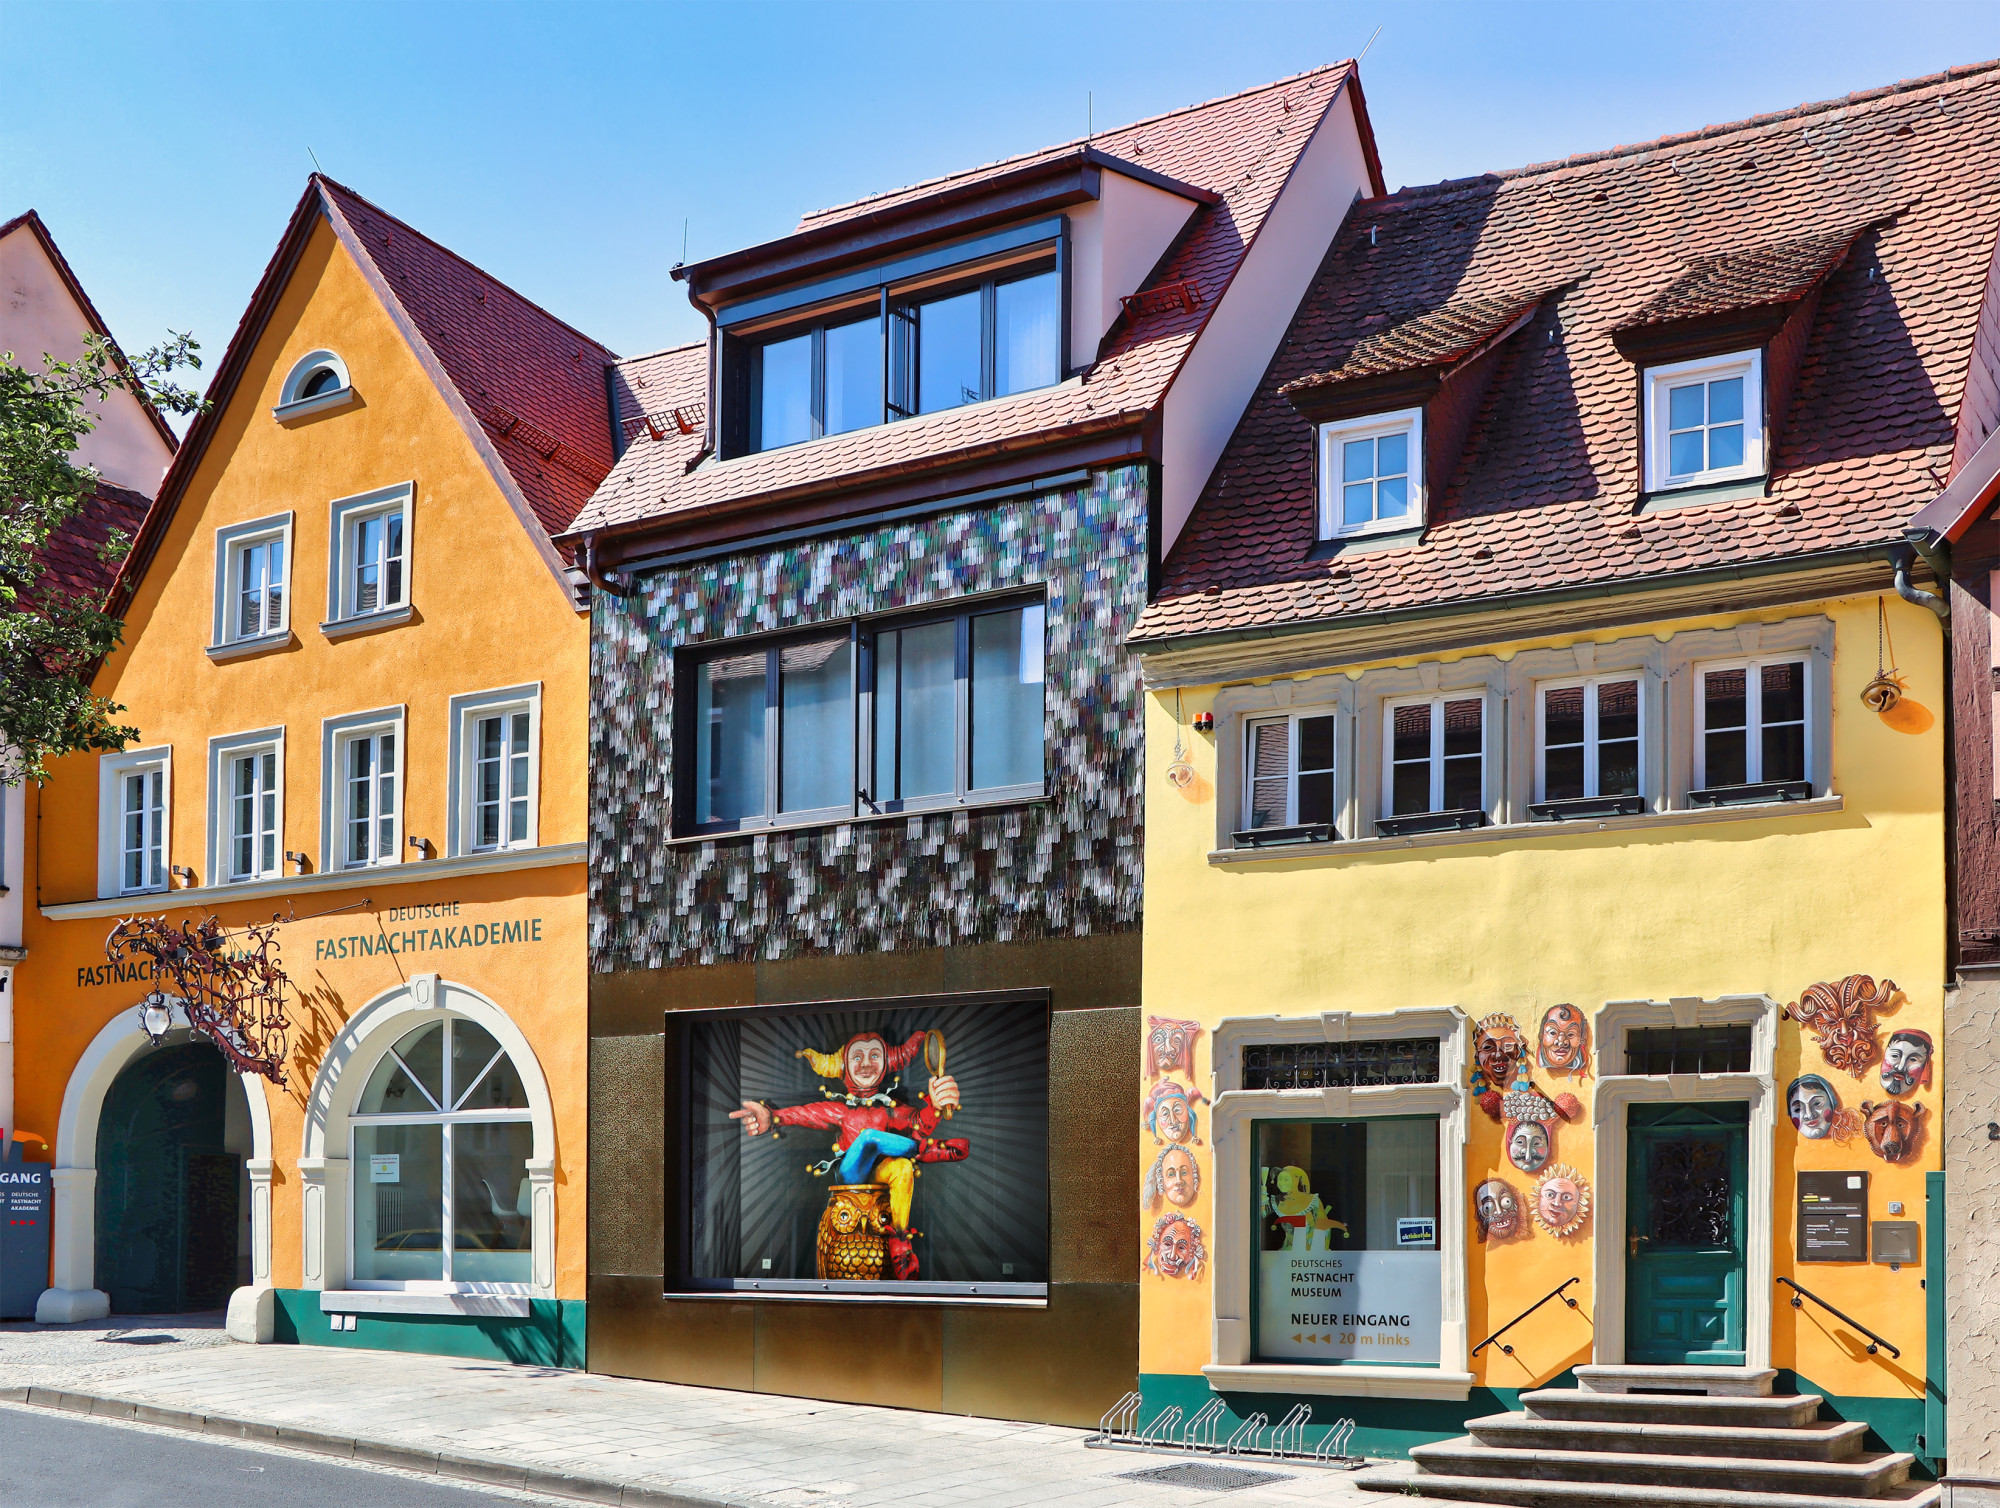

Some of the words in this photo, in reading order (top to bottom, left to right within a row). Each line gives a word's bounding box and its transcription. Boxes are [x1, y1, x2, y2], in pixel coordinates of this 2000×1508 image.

[389, 900, 460, 922] DEUTSCHE
[315, 918, 542, 961] FASTNACHTAKADEMIE
[1291, 1259, 1343, 1268] DEUTSCHES
[1291, 1273, 1355, 1283] FASTNACHT
[1290, 1287, 1342, 1298] MUSEUM
[1291, 1313, 1338, 1326] NEUER
[1342, 1314, 1410, 1327] EINGANG
[1339, 1332, 1356, 1345] 20
[1360, 1335, 1373, 1345] m
[1377, 1332, 1410, 1346] links
